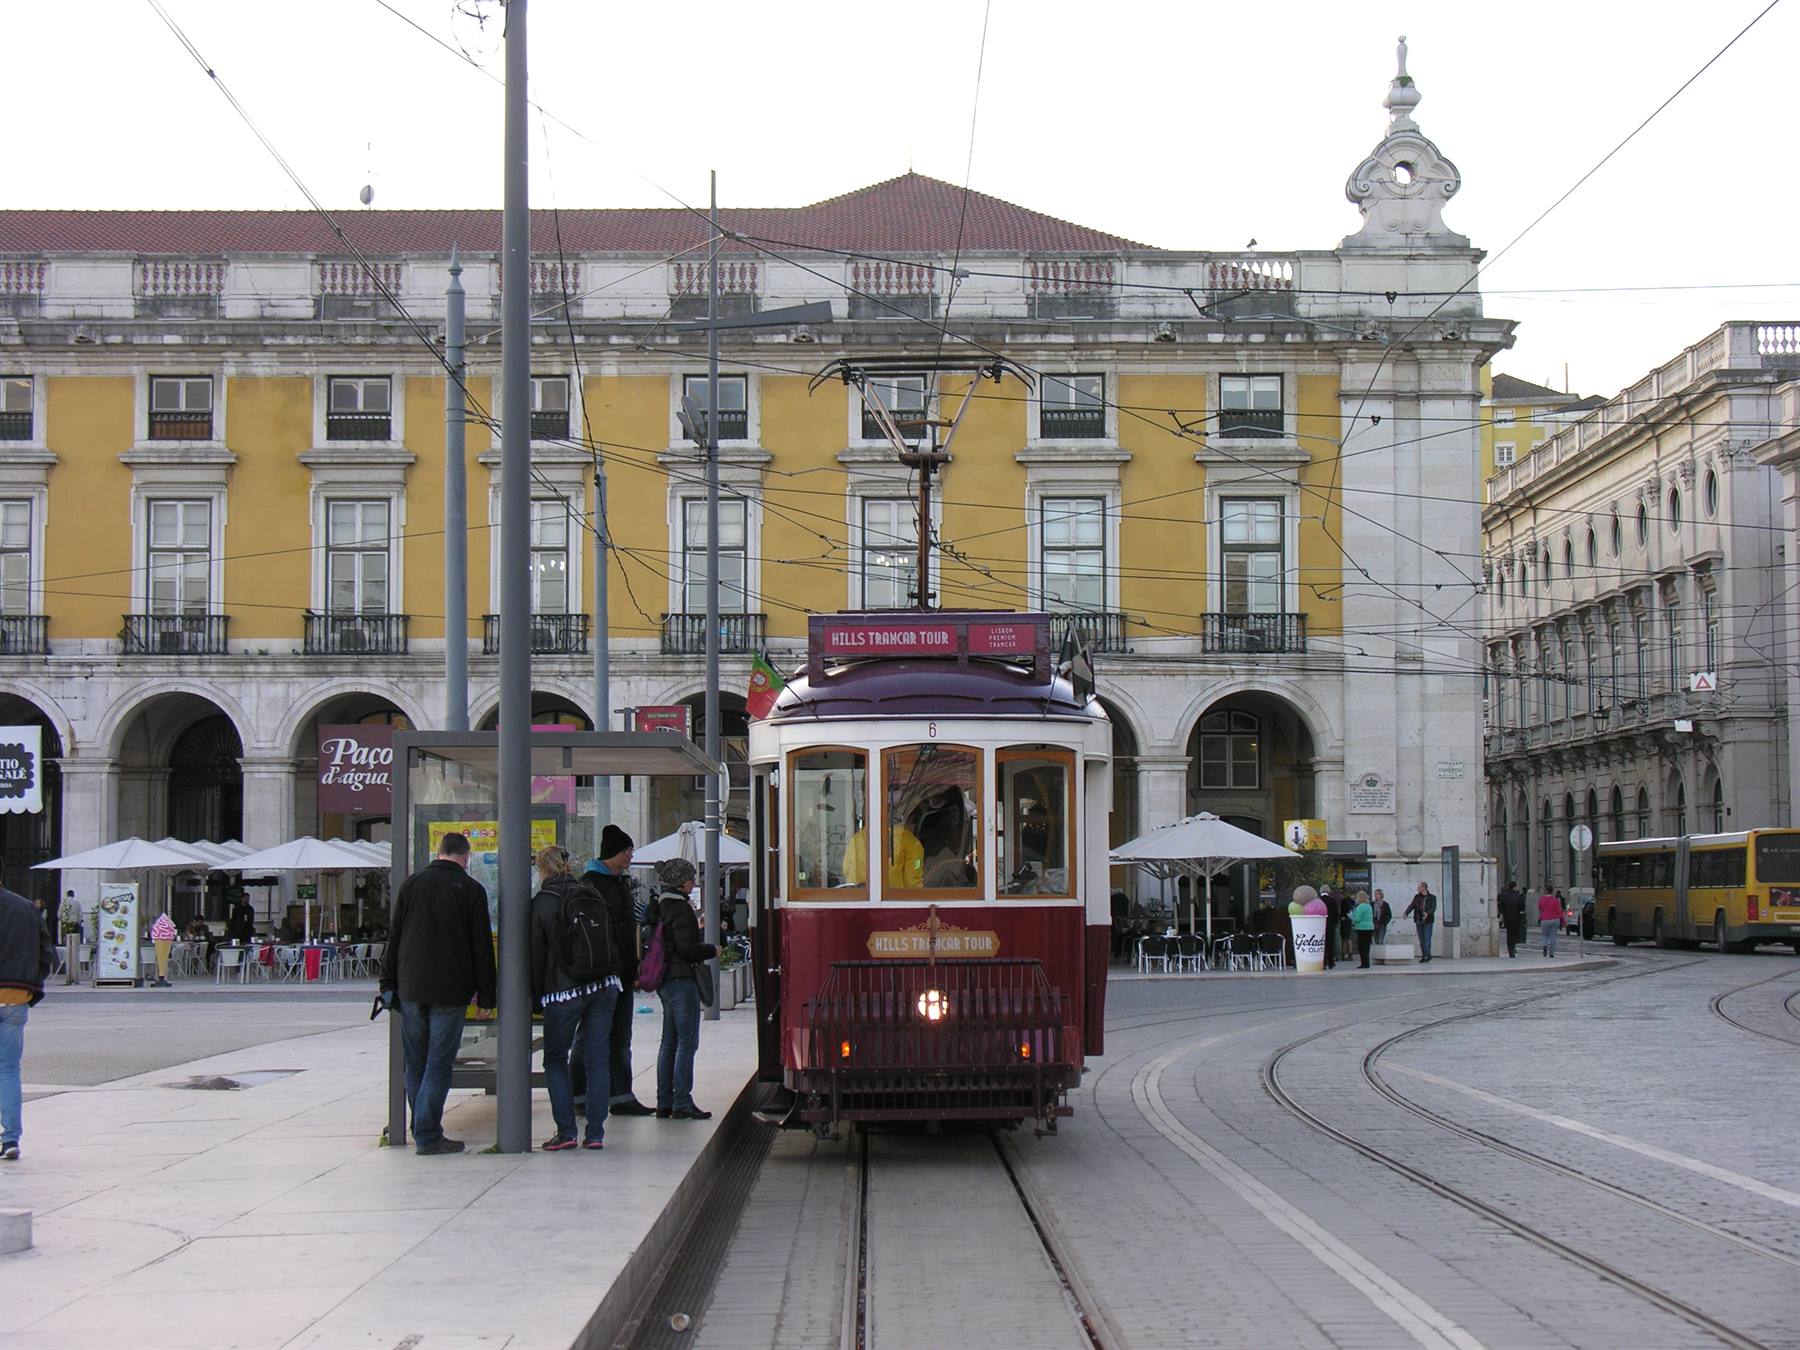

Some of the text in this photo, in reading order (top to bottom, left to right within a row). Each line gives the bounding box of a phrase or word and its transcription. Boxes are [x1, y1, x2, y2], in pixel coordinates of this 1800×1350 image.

[831, 630, 949, 647] HILLS TRAMCAR TOUR
[928, 722, 937, 738] 6
[321, 738, 393, 769] Paço
[0, 758, 19, 769] TIO
[875, 936, 910, 952] HILLS
[963, 936, 993, 951] TOUR
